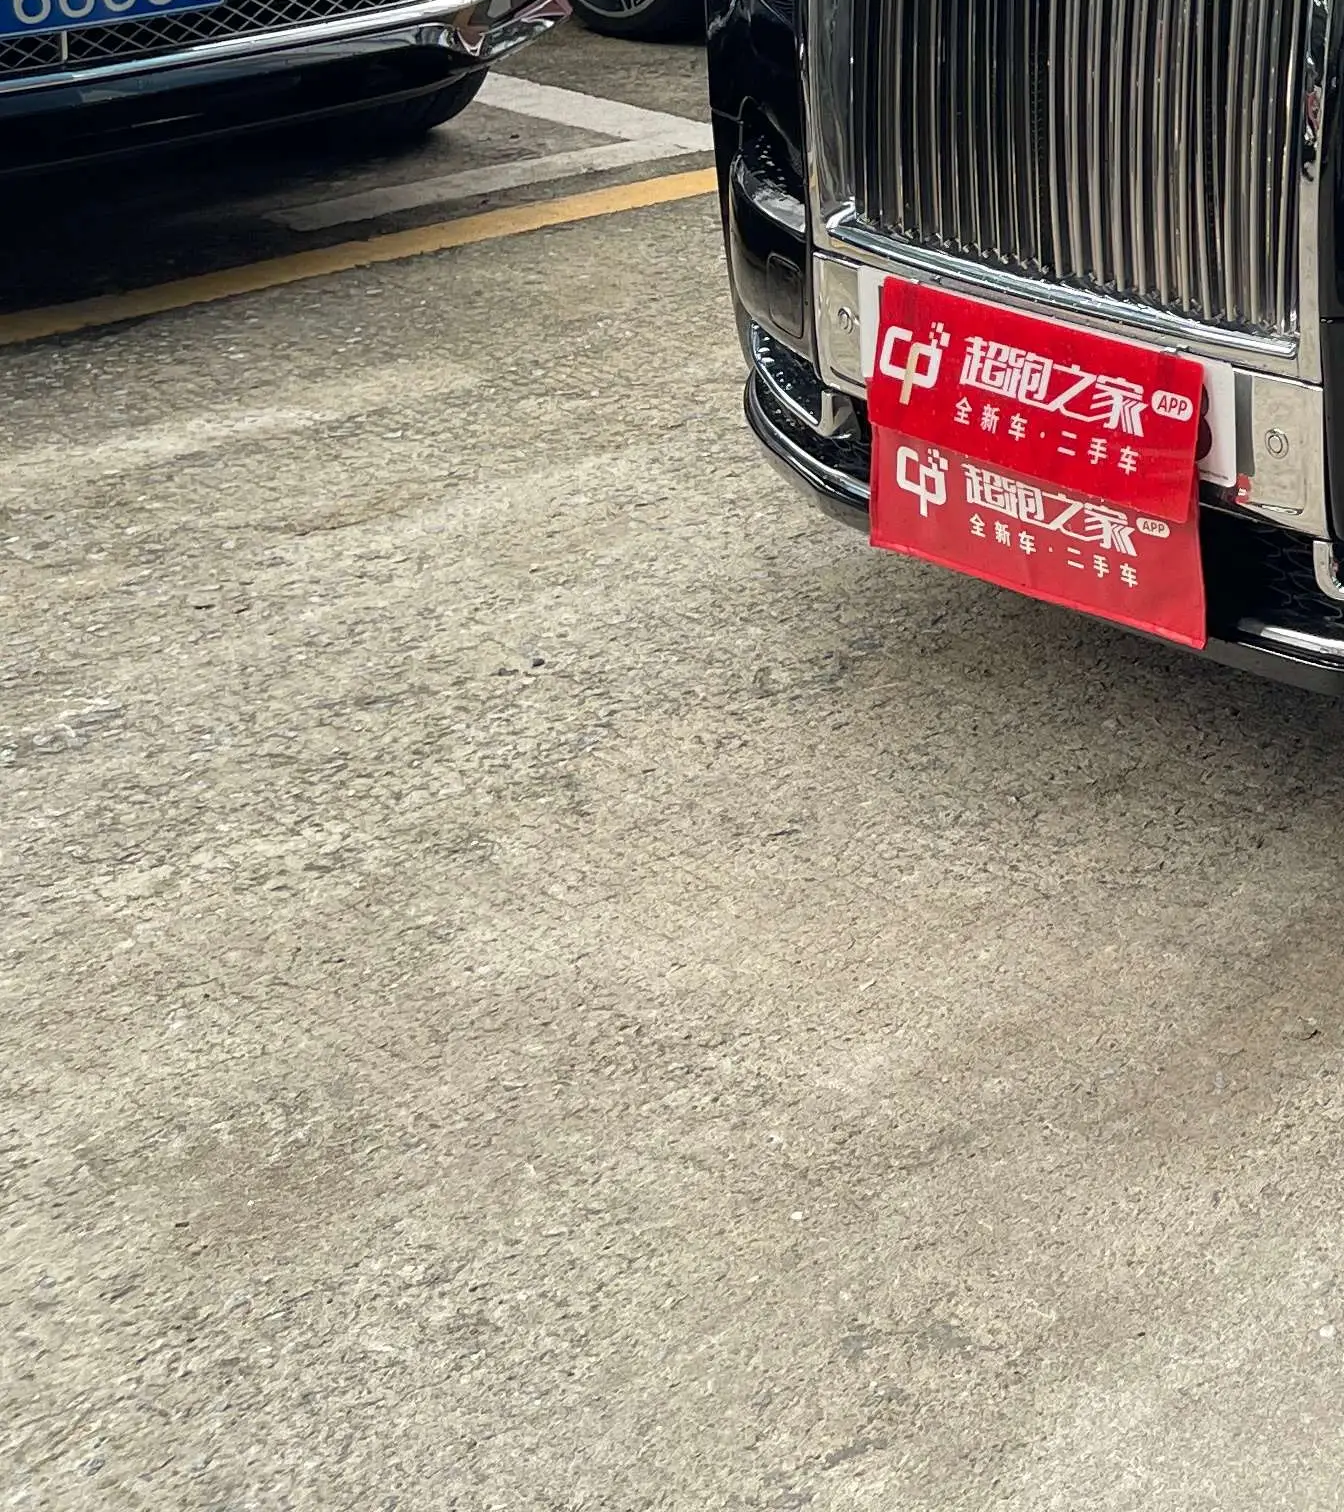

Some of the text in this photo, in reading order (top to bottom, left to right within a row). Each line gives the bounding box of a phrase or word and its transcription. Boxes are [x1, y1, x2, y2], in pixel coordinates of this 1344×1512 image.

[959, 335, 1148, 438] 超跑之家
[961, 462, 1138, 557] 超跑之家
